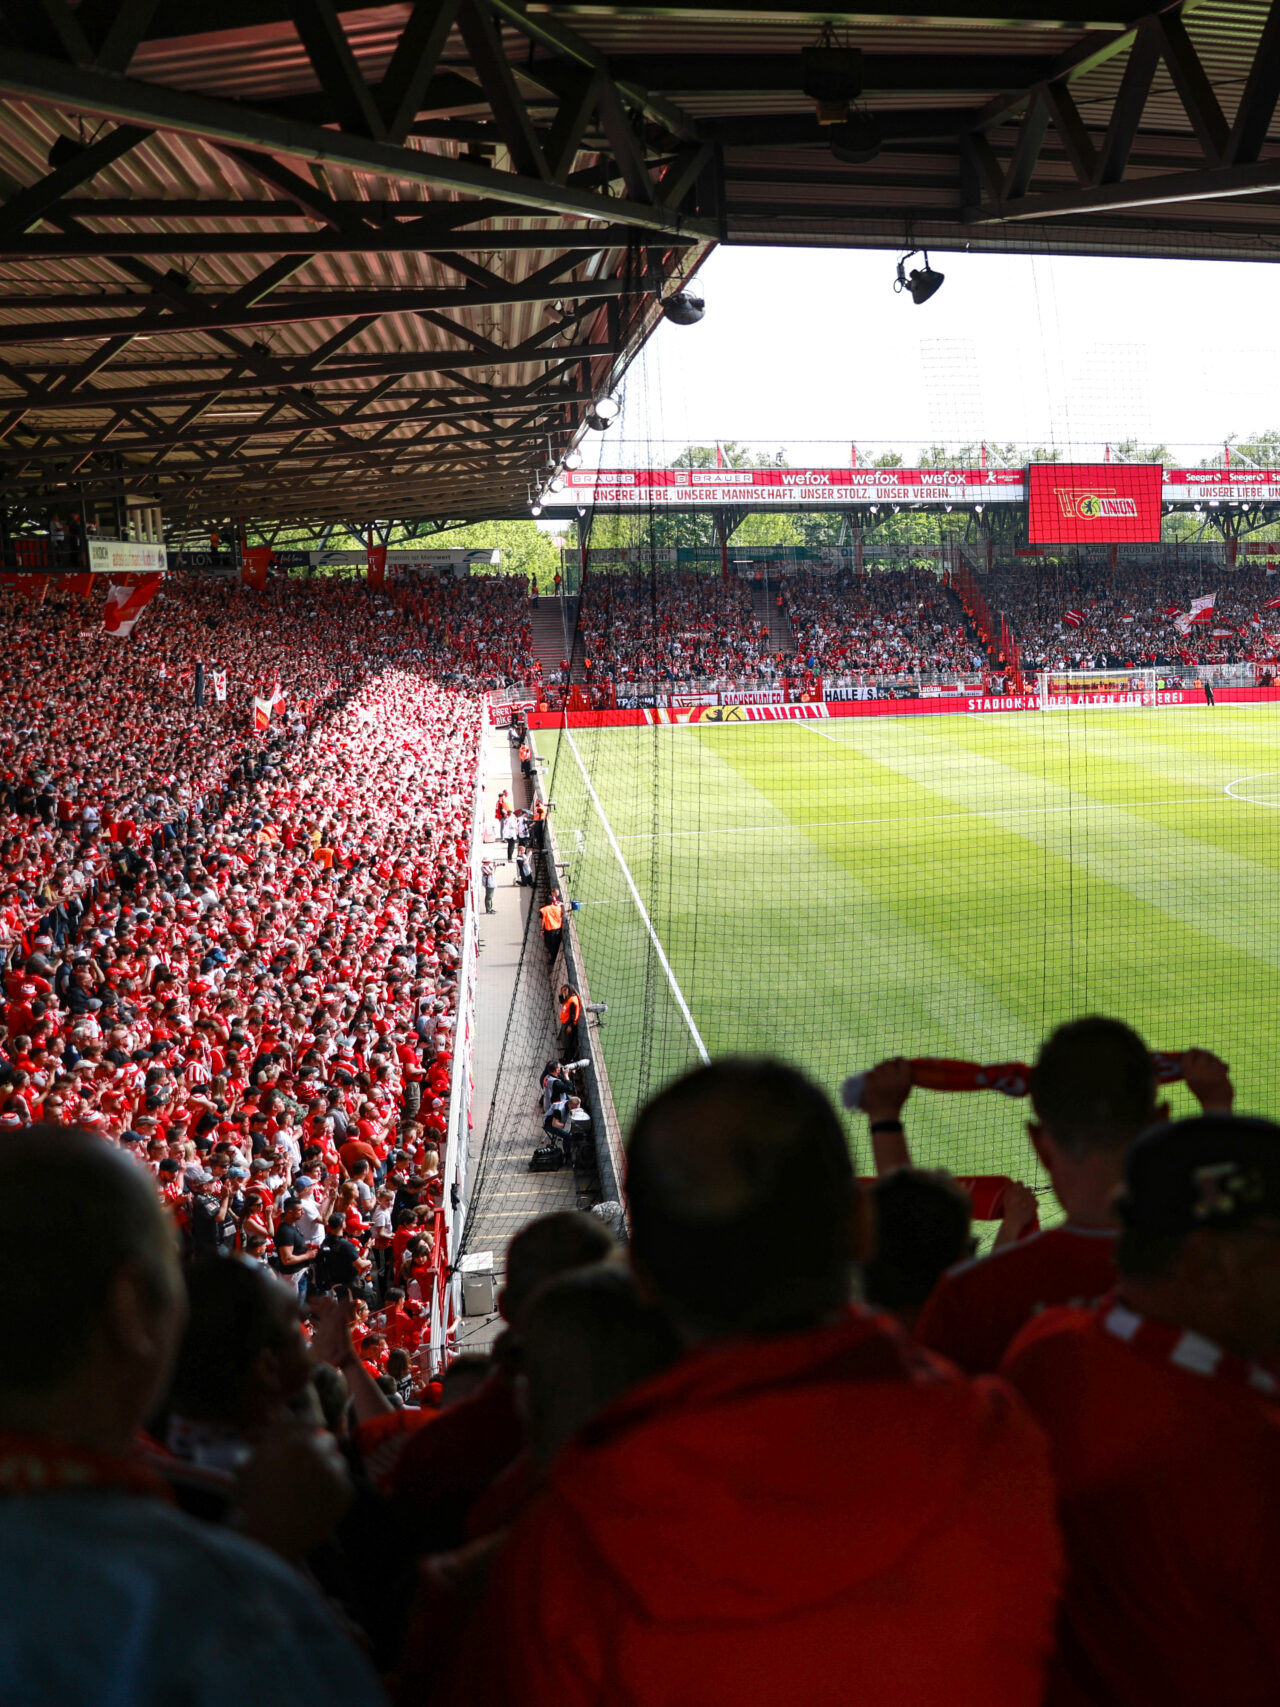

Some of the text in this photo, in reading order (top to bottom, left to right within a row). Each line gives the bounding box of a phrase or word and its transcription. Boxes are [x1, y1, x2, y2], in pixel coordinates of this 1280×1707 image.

[693, 474, 753, 482] BRAUER
[781, 472, 829, 485] wefox
[851, 472, 898, 485] wefox
[920, 472, 965, 484] wefox
[1186, 473, 1213, 482] Seeger
[1229, 473, 1255, 482] Seeger
[593, 487, 951, 501] UNSERE LIEBE. UNSERE MANNSCHAFT. UNSER STOLZ. UNSER VEREIN.
[1200, 487, 1234, 497] UNSERE
[1237, 487, 1265, 497] LIEBE.
[1101, 499, 1136, 515] UNION
[723, 693, 783, 705] SACHSENADLER
[825, 688, 859, 702] HALLE
[867, 688, 877, 701] S.
[968, 692, 1183, 709] STADION AN DER ALTEN FÖRSTEREI
[746, 705, 823, 720] UNION
